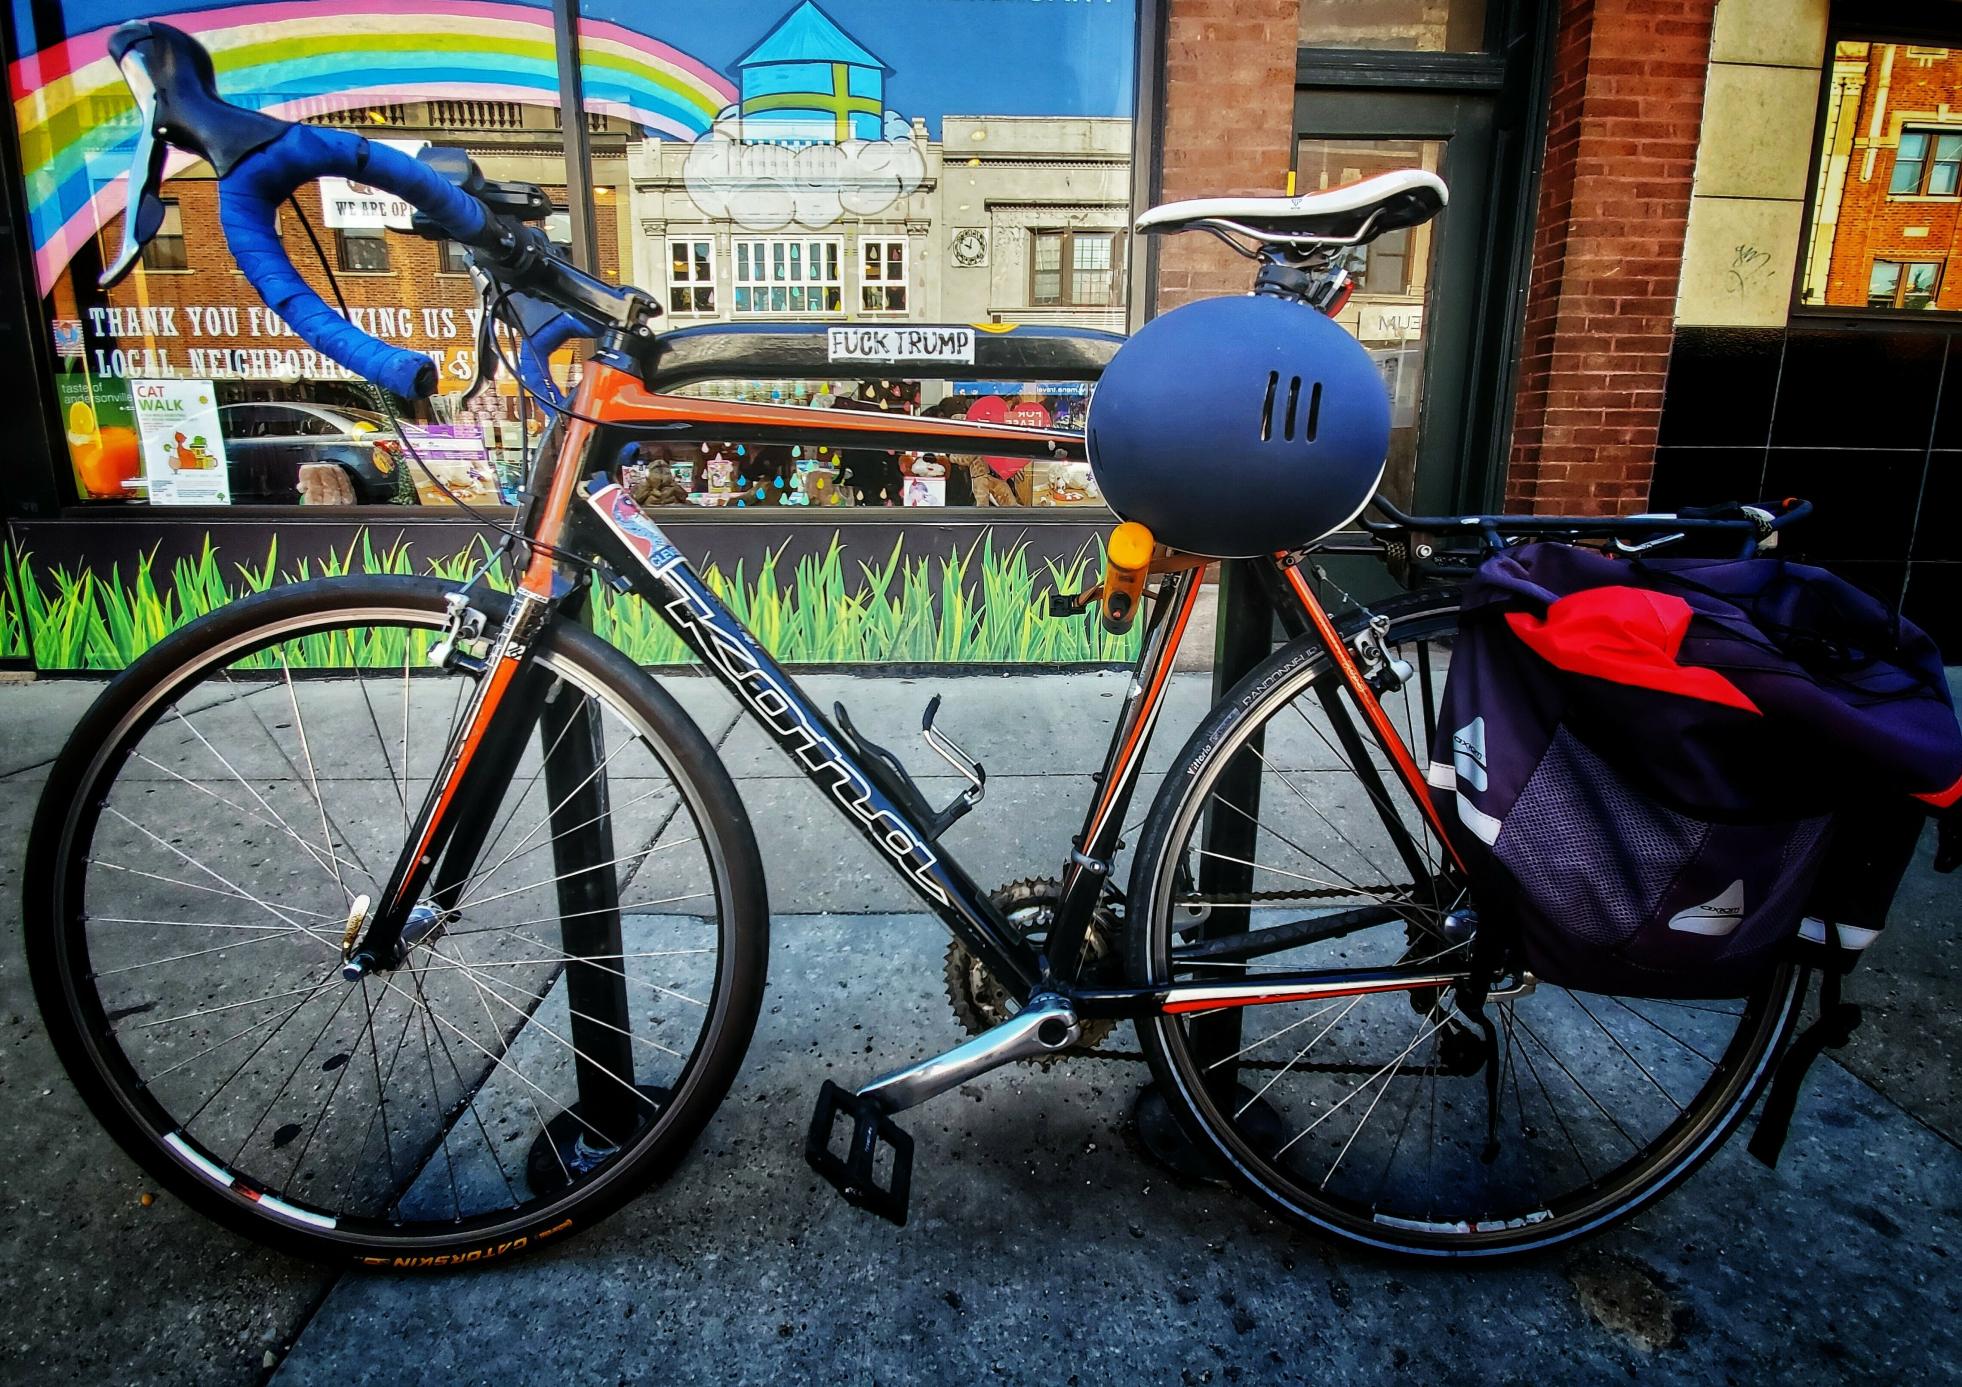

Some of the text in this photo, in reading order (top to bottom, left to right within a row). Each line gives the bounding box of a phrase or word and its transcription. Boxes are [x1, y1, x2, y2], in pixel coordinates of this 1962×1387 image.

[335, 201, 414, 217] WE ARE OP
[89, 307, 180, 337] THANK
[185, 307, 239, 337] YOU
[423, 308, 457, 338] US
[832, 331, 968, 356] FUCK TRUMP
[61, 382, 103, 394] taste of
[137, 386, 165, 398] CAT
[139, 399, 184, 411] WALK
[393, 1237, 527, 1267] GATORSKIN
